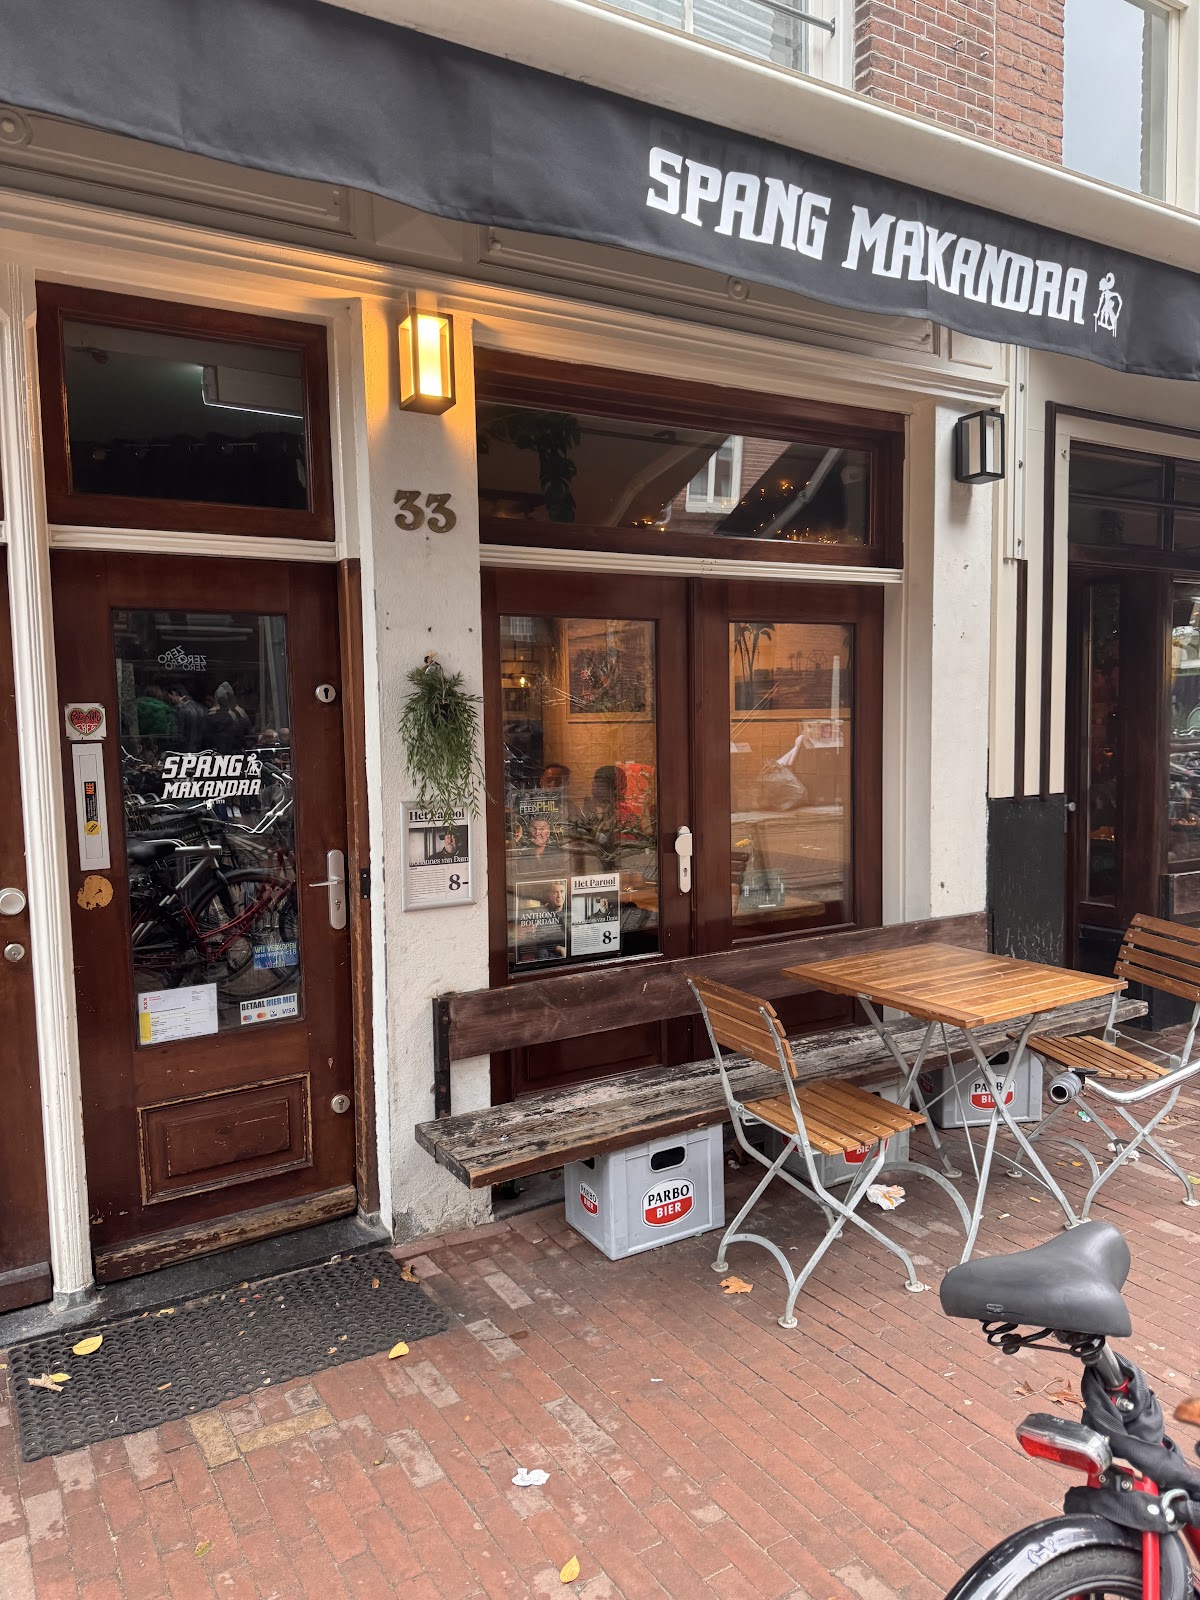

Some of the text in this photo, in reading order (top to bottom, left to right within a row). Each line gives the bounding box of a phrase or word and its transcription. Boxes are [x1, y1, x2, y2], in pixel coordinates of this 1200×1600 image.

[645, 146, 1088, 325] SPANG MAKANDRA
[393, 489, 457, 534] 33
[161, 754, 245, 779] SPANG
[86, 782, 95, 795] NEE
[160, 779, 261, 799] MAKANDRA
[519, 800, 559, 814] FEED PHIL
[409, 811, 428, 821] Het
[453, 855, 469, 863] Dam
[449, 873, 469, 891] 8-
[574, 876, 616, 888] Het Parool
[520, 911, 558, 920] ANTHONY
[520, 917, 560, 927] BOURDAIN
[602, 930, 618, 945] 8-
[267, 942, 297, 952] VERKOPEN
[241, 995, 296, 1011] BETAAL HIER MET
[580, 1184, 597, 1203] PARBO
[647, 1184, 690, 1206] PARBO
[583, 1197, 594, 1210] BIER
[656, 1202, 682, 1219] BIER
